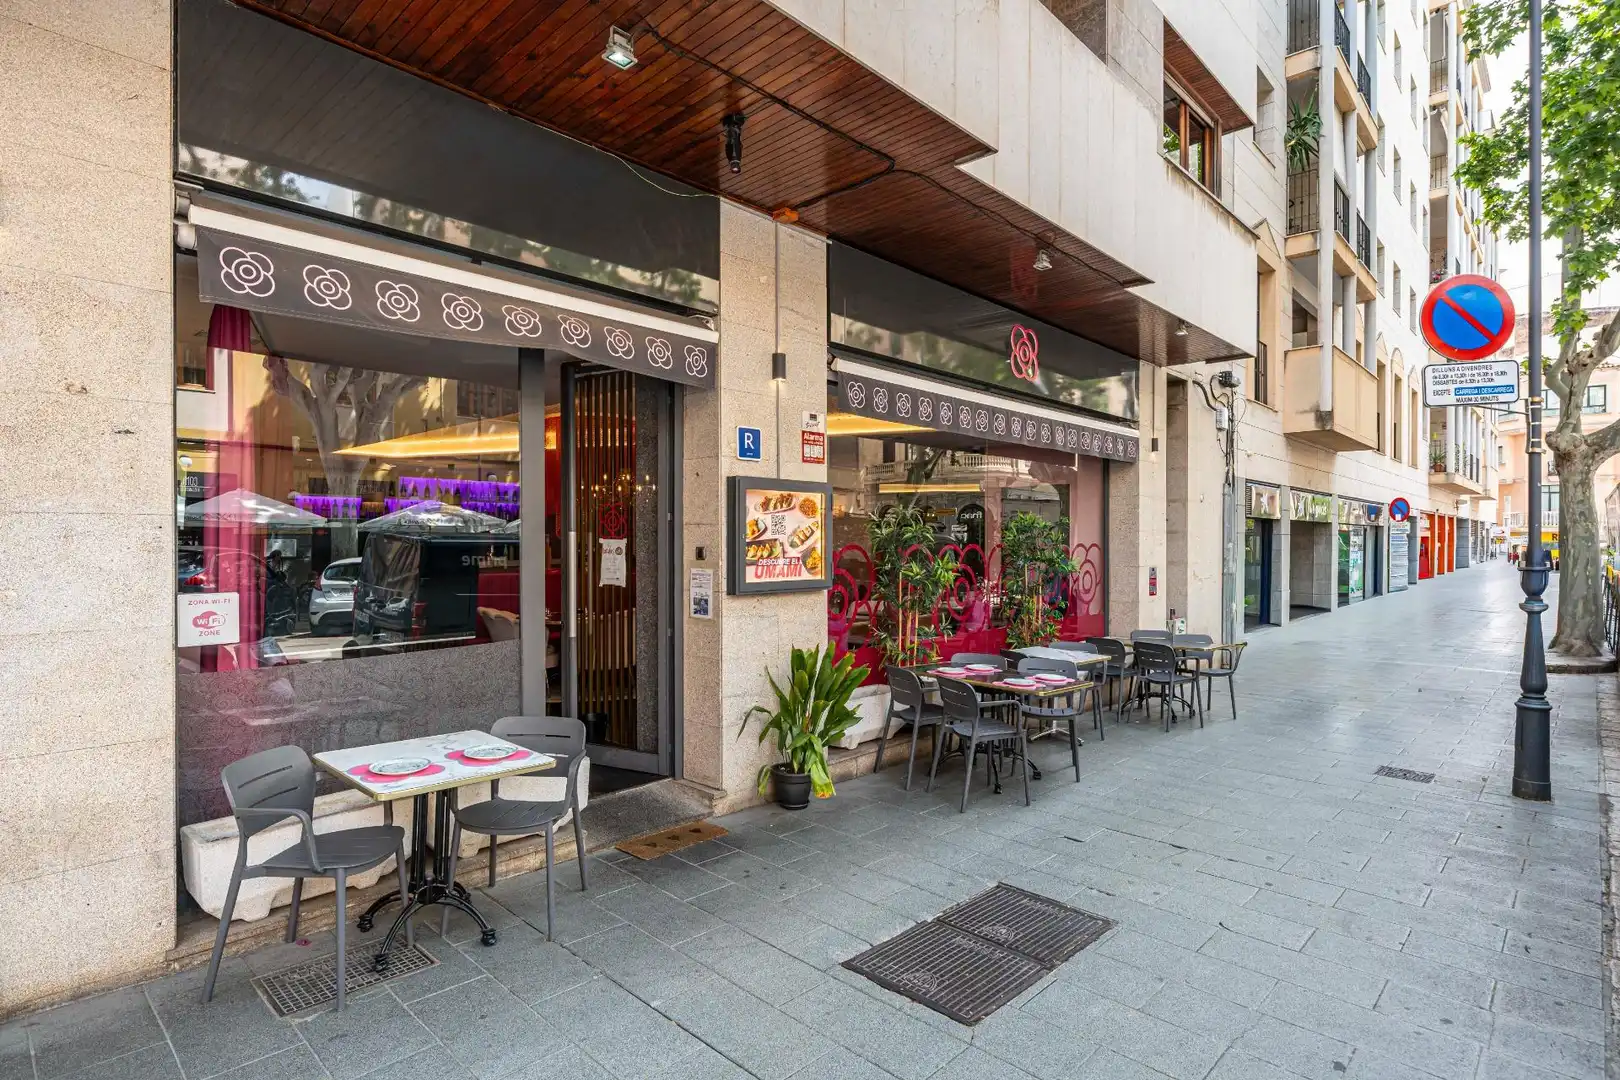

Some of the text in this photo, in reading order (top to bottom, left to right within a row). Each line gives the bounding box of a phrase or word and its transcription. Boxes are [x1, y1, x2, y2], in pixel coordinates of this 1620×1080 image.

[1461, 364, 1492, 372] DIVENDRES
[744, 432, 754, 450] R
[804, 432, 824, 441] Alarma
[754, 564, 802, 579] UMAMI
